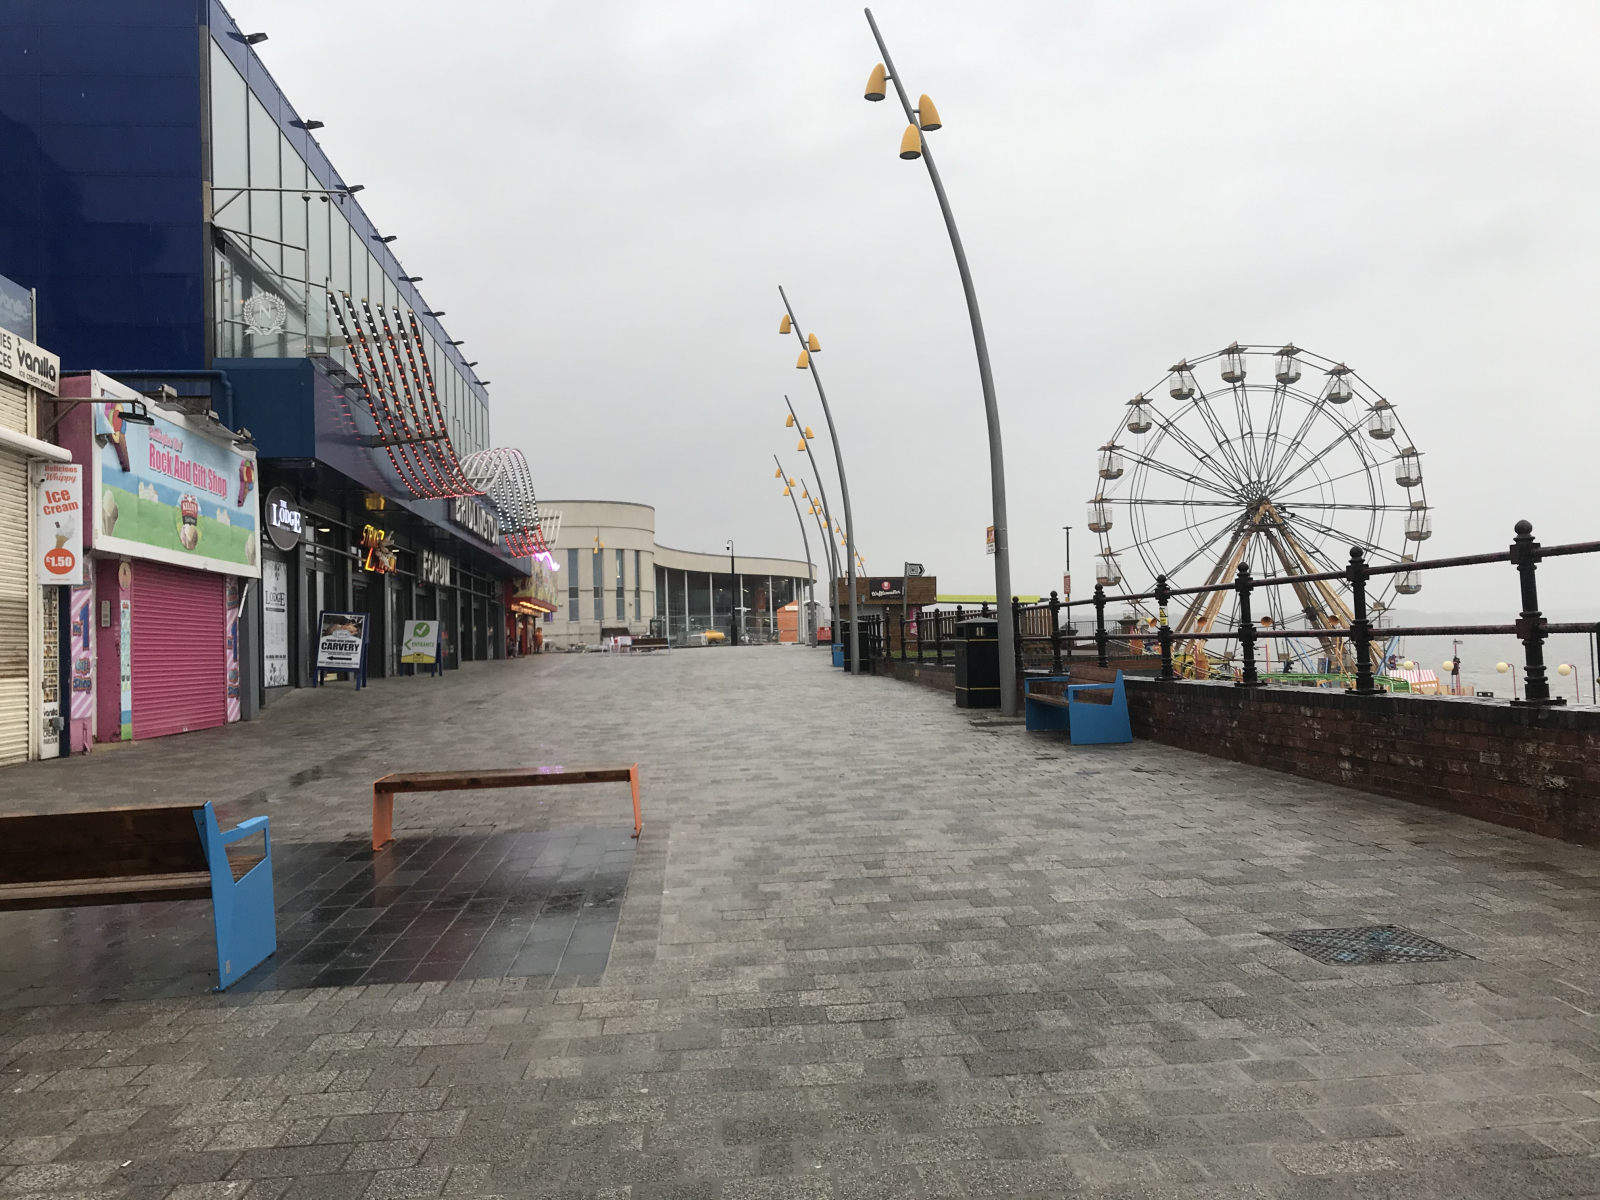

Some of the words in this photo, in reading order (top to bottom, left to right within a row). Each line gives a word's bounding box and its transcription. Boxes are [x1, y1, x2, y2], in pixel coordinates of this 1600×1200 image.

[44, 465, 78, 473] Delicious
[149, 442, 173, 476] Rock
[173, 454, 192, 484] And
[192, 462, 207, 489] Gift
[207, 468, 228, 498] Shop
[44, 472, 77, 484] Whippy
[45, 489, 71, 505] Ice
[43, 501, 79, 516] Cream
[271, 503, 302, 534] LODGE
[46, 556, 73, 567] £1.50
[423, 549, 451, 586] FORUM
[321, 641, 360, 652] CARVERY
[73, 676, 92, 694] Shop
